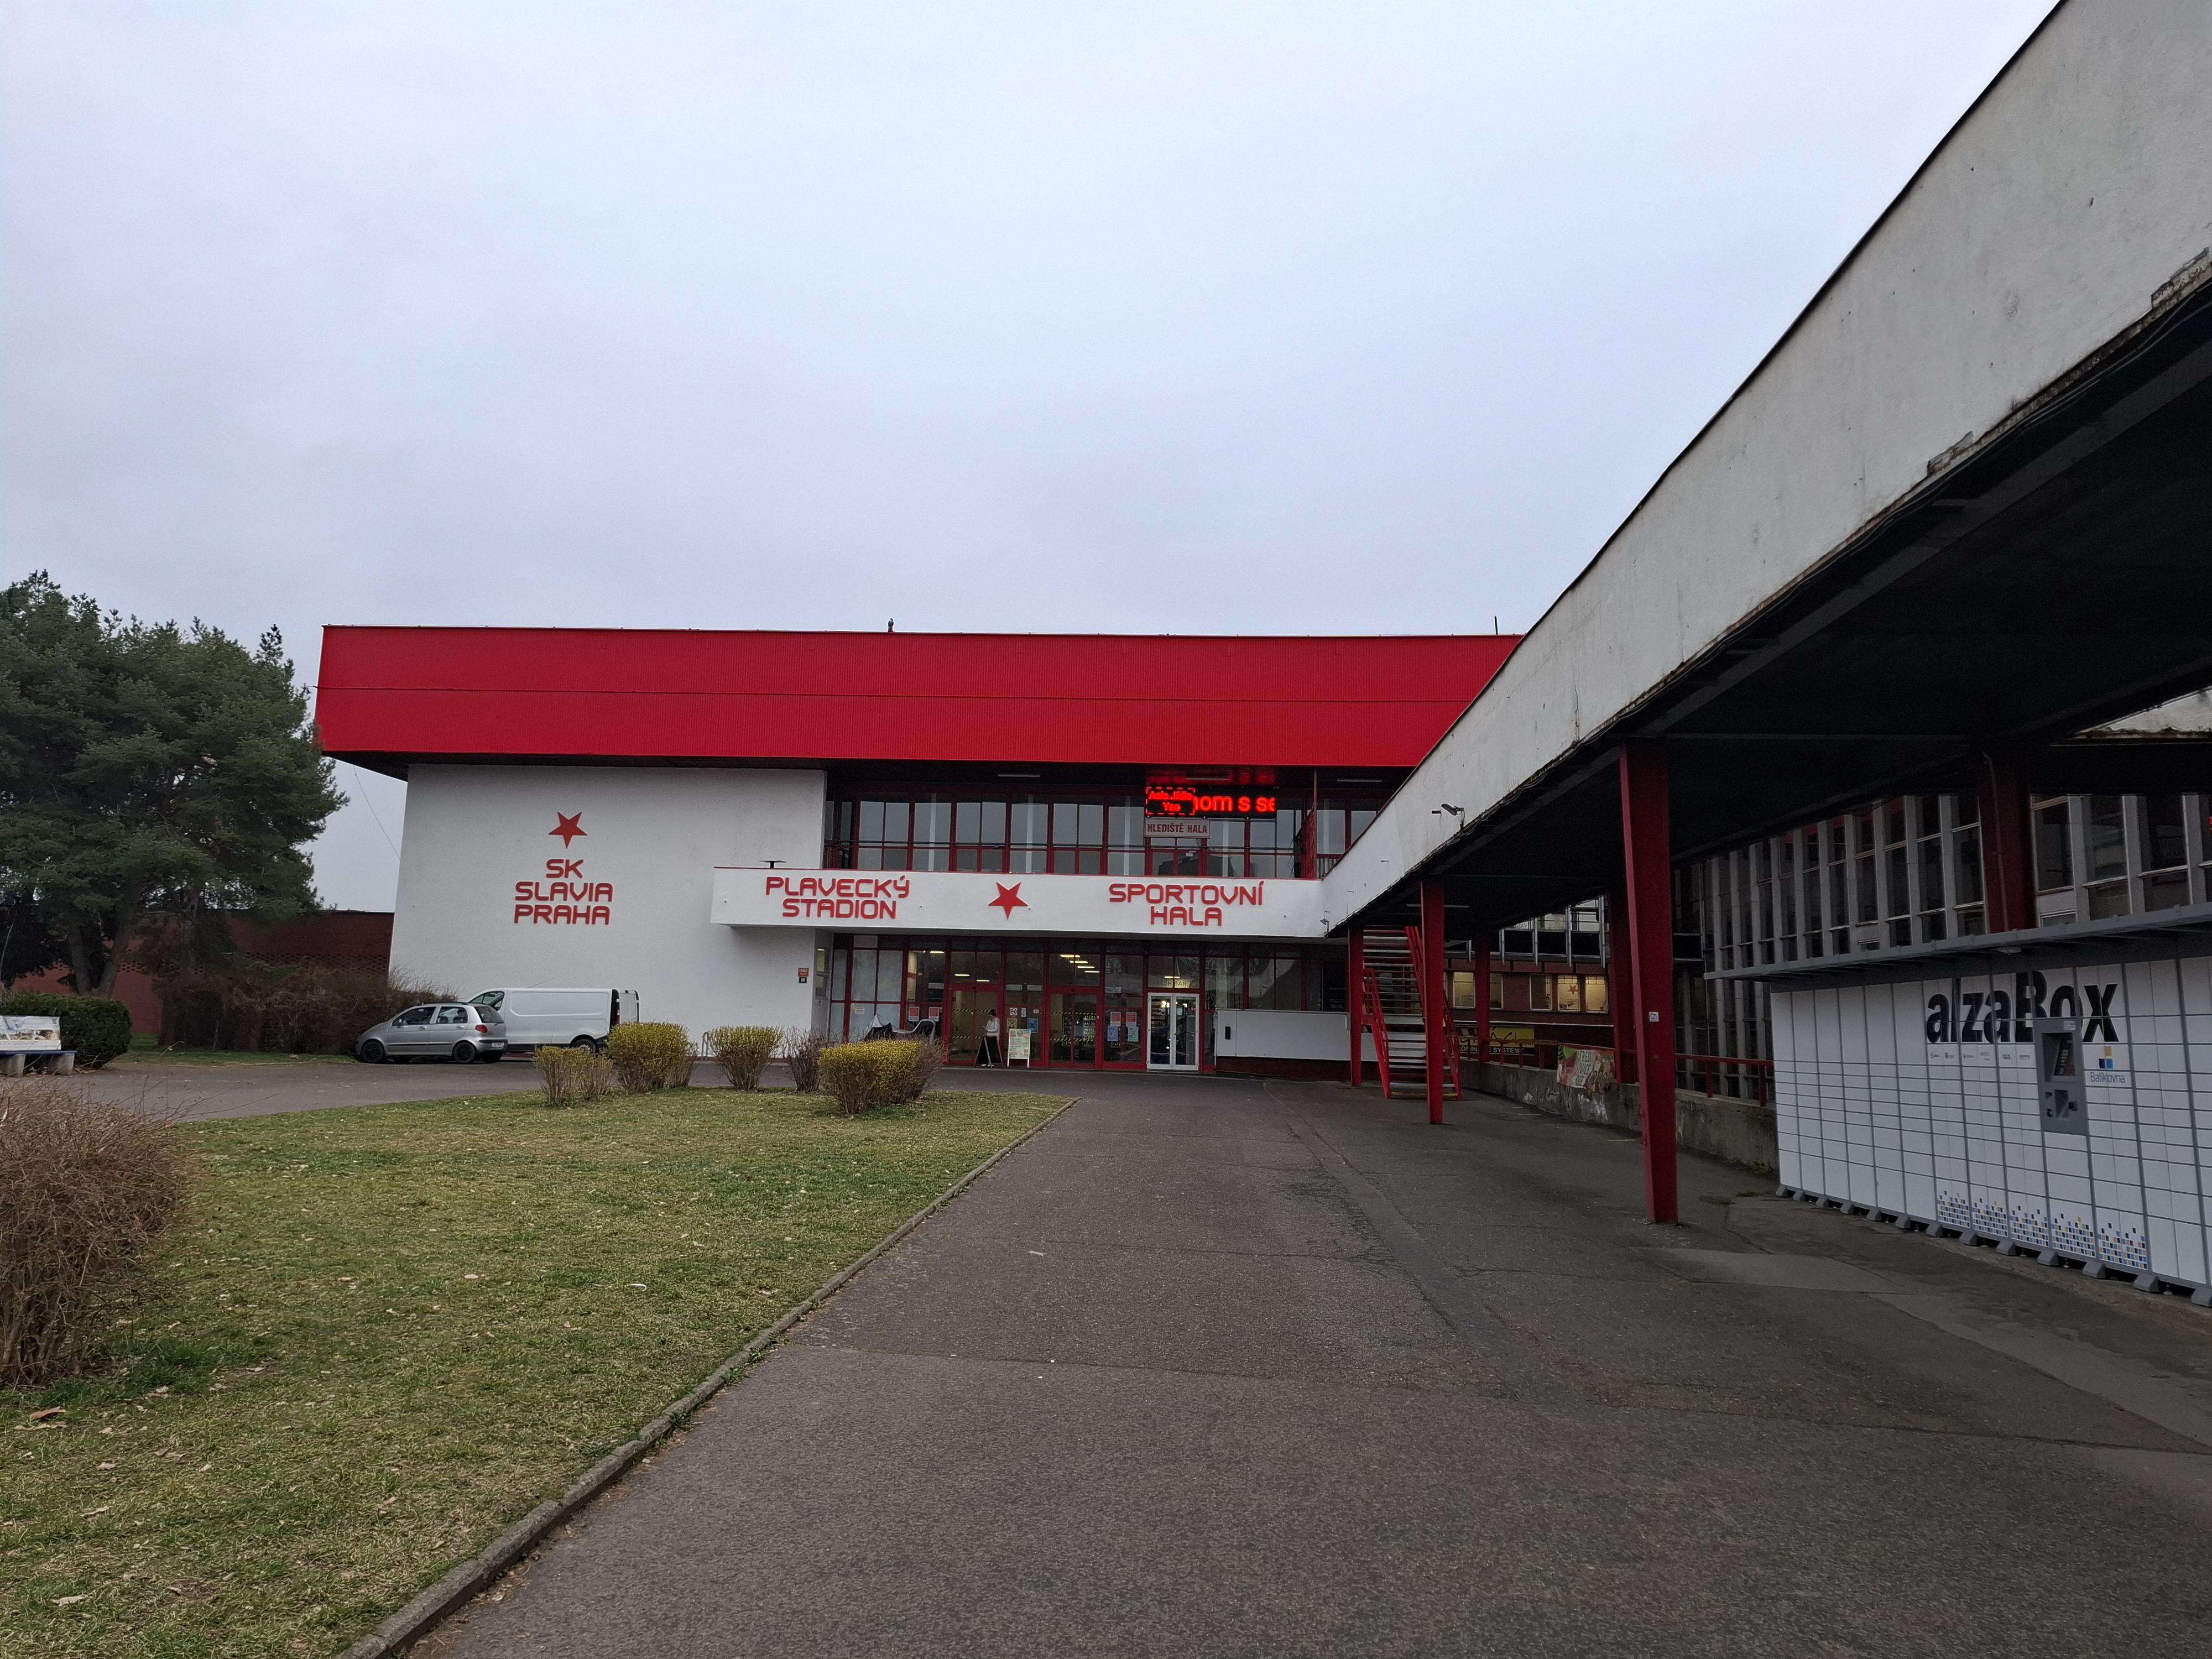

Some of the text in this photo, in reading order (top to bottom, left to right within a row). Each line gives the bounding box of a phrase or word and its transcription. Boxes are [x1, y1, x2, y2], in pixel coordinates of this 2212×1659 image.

[1238, 796, 1252, 812] s
[1147, 822, 1208, 834] HLEDIŠTĚ HALA
[545, 858, 585, 879] SK
[514, 881, 614, 902] SLAVIA
[765, 875, 911, 899] PLAVECKÝ
[1109, 880, 1265, 905] SPORTOVNÍ
[514, 904, 611, 925] PRAHA
[782, 898, 898, 920] STADION
[1150, 905, 1223, 926] HALA
